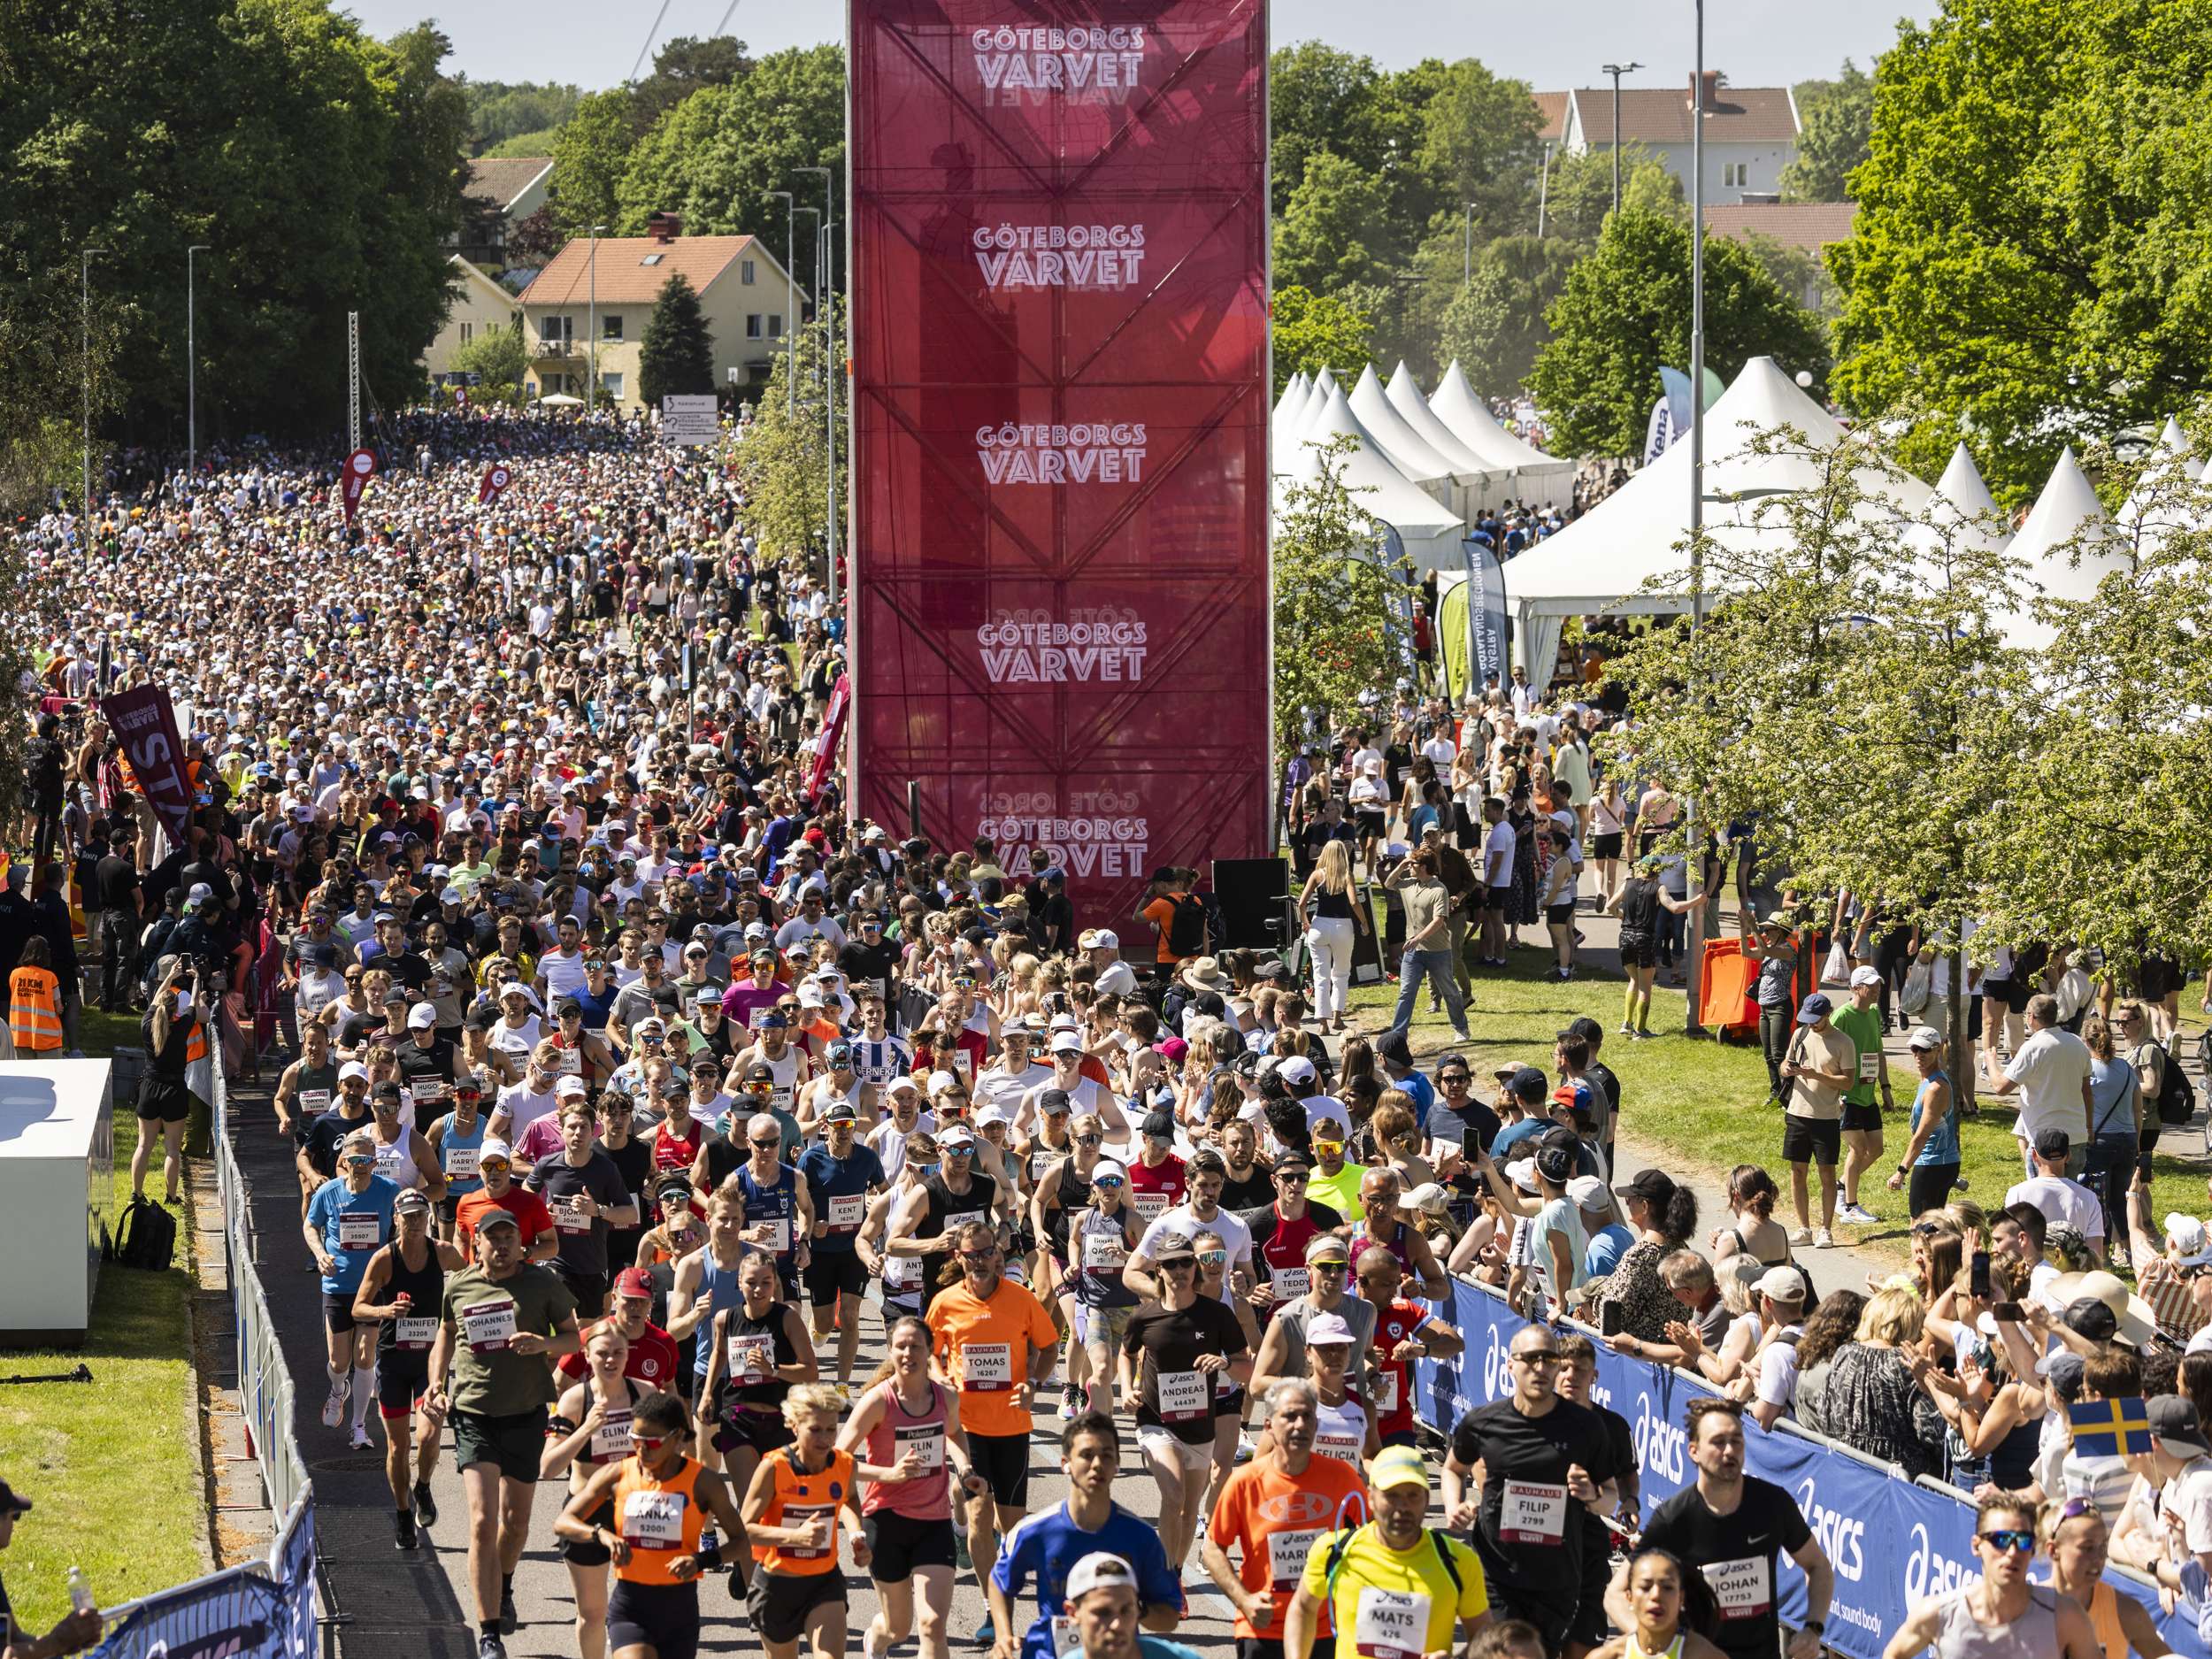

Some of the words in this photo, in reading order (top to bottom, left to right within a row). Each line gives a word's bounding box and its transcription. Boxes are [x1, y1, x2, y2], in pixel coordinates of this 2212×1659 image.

[972, 25, 1144, 51] GÖTEBORGS
[974, 52, 1143, 88] VARVET
[973, 223, 1145, 249] GÖTEBORGS
[975, 250, 1144, 286] VARVET
[976, 421, 1147, 447] GÖTEBORGS
[977, 449, 1146, 484] VARVET
[495, 473, 504, 484] 5
[977, 620, 1147, 646] GÖTEBORGS
[979, 647, 1147, 681] VARVET
[978, 816, 1148, 841] GÖTEBORGS
[856, 1066, 896, 1078] SERNEKE
[838, 1206, 856, 1215] KENT
[399, 1319, 437, 1329] JENNIFER
[467, 1314, 512, 1329] JOHANNES
[731, 1349, 772, 1361] VIKTA
[965, 1346, 1006, 1355] BAUHAUS
[968, 1357, 1006, 1367] TOMAS
[1162, 1385, 1205, 1397] ANDREAS
[1173, 1398, 1196, 1407] 44439
[910, 1440, 933, 1452] ELIN
[1316, 1435, 1359, 1446] BAUHAUS
[1649, 1415, 1686, 1486] asics
[1510, 1486, 1562, 1498] BAUHAUS
[1519, 1501, 1551, 1513] FILIP
[636, 1509, 671, 1521] ANNA
[1522, 1516, 1545, 1525] 2799
[1810, 1503, 1864, 1582] asics
[1730, 1562, 1755, 1572] asics
[1715, 1576, 1759, 1594] JOHAN
[1371, 1610, 1415, 1626] MATS
[1841, 1604, 1863, 1627] sound
[1863, 1608, 1882, 1639] body
